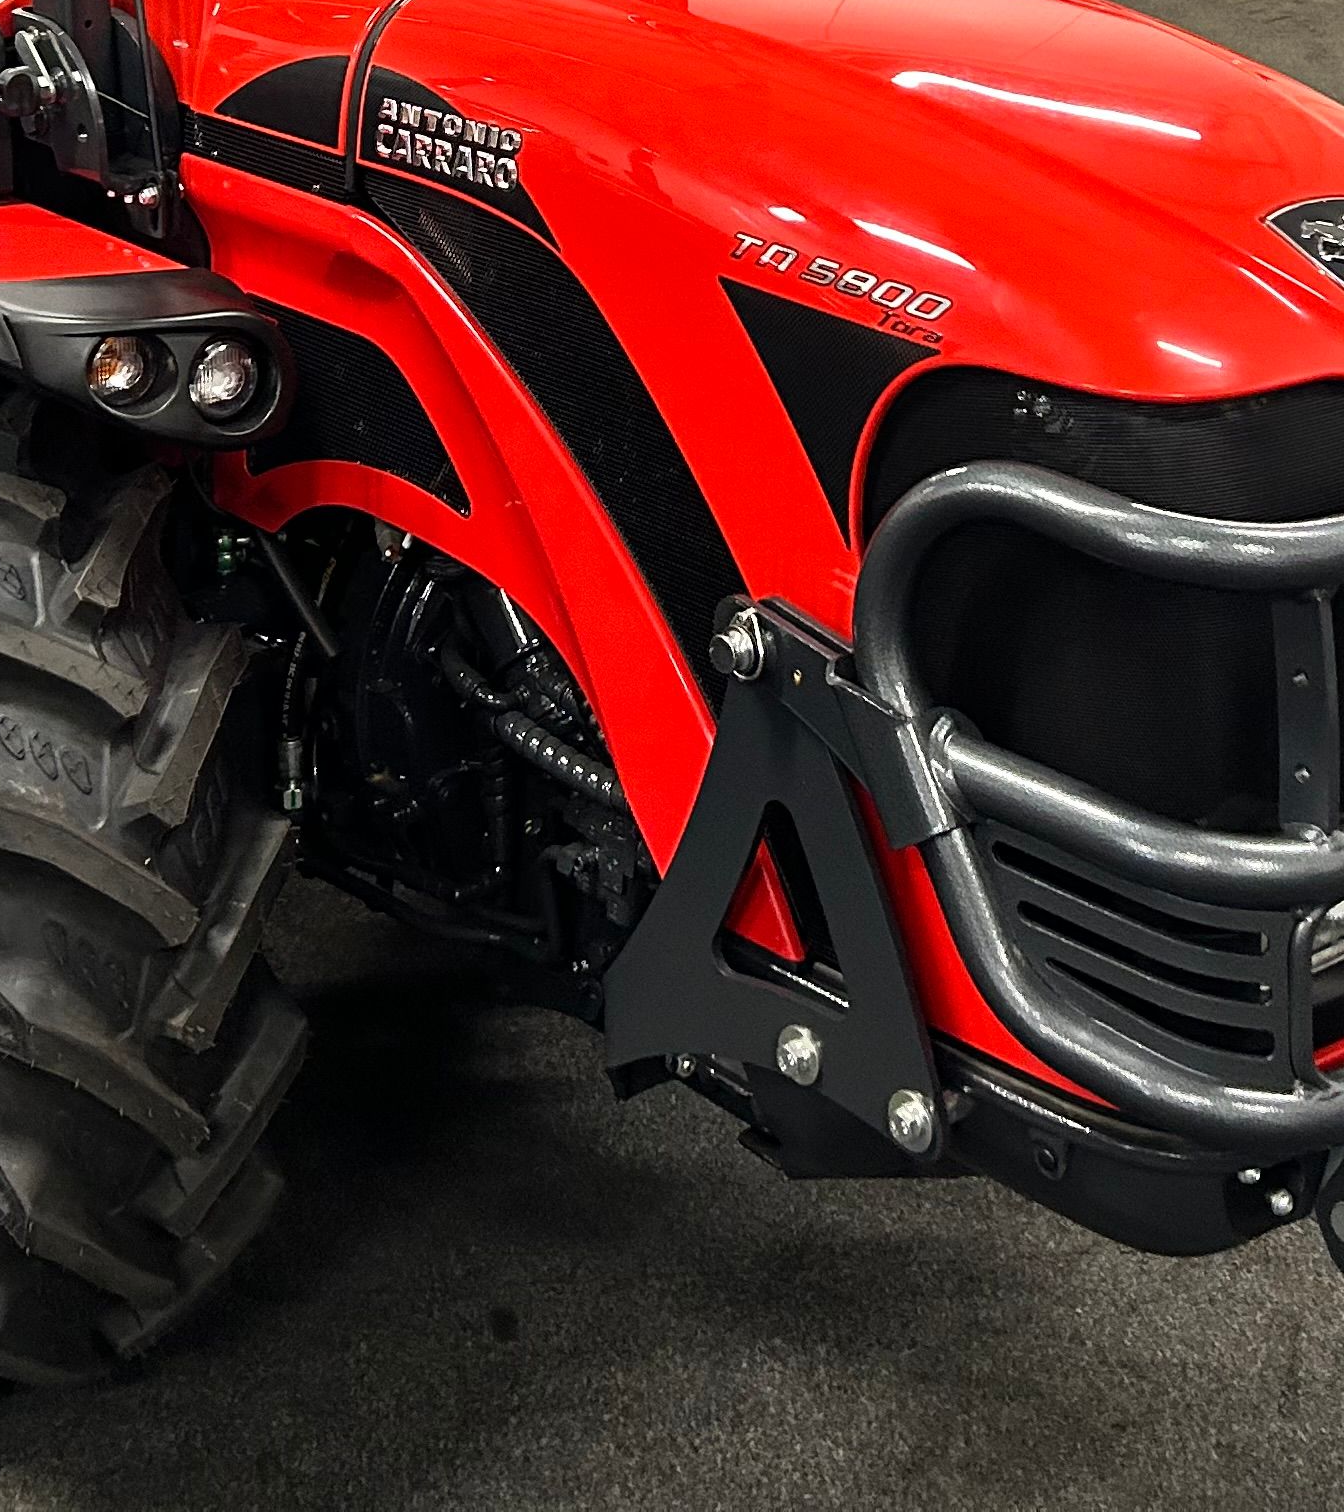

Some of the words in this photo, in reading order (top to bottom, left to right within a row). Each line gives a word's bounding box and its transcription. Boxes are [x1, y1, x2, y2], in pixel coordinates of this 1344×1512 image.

[375, 123, 519, 190] CARRARO
[377, 97, 522, 152] ANTONIO
[799, 255, 954, 322] 5800
